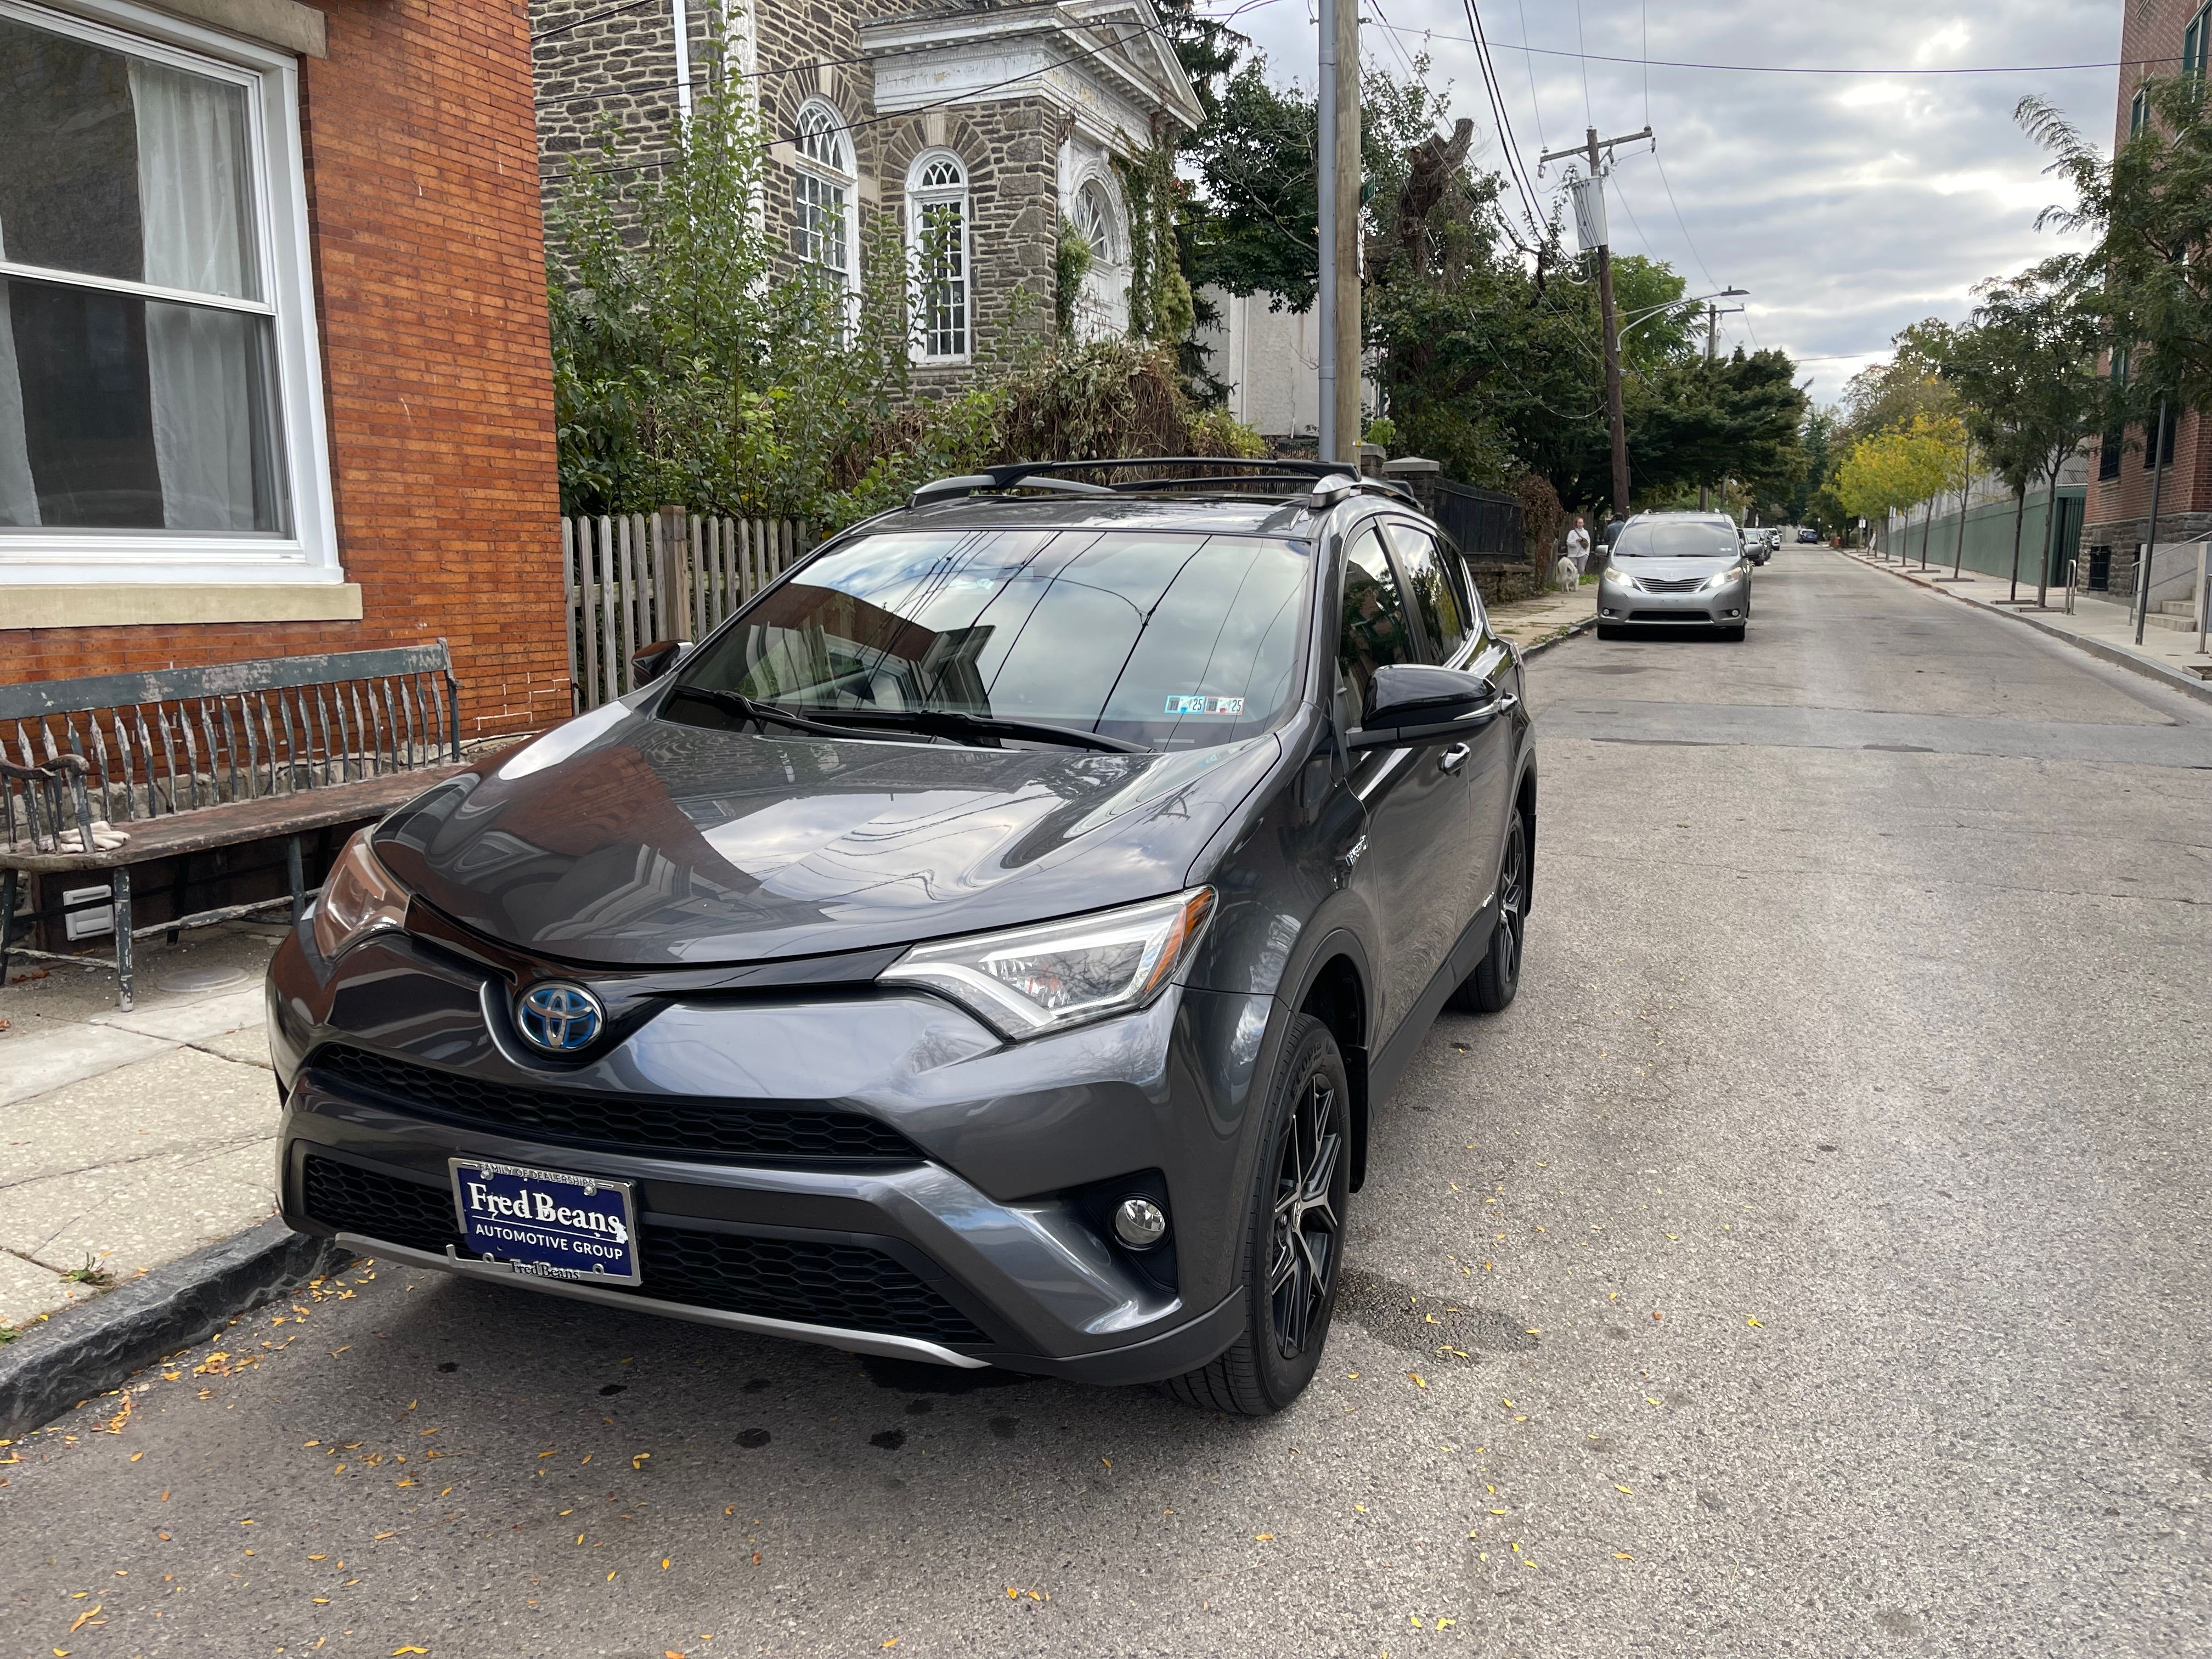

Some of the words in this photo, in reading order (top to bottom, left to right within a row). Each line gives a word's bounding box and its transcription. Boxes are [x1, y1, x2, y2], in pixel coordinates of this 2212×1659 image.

[1170, 700, 1179, 710] 10
[1192, 698, 1203, 710] 25
[1208, 701, 1217, 712] 10
[1232, 699, 1242, 712] 25
[479, 1164, 513, 1175] FAMILY
[516, 1168, 529, 1177] OF
[532, 1170, 596, 1188] DEALERSHIPS
[467, 1182, 533, 1218] Fred
[533, 1193, 623, 1234] Beans
[476, 1224, 568, 1251] AUTOMOTIVE
[573, 1242, 623, 1260] GROUP
[510, 1259, 539, 1275] Fred
[539, 1262, 580, 1280] Beans
